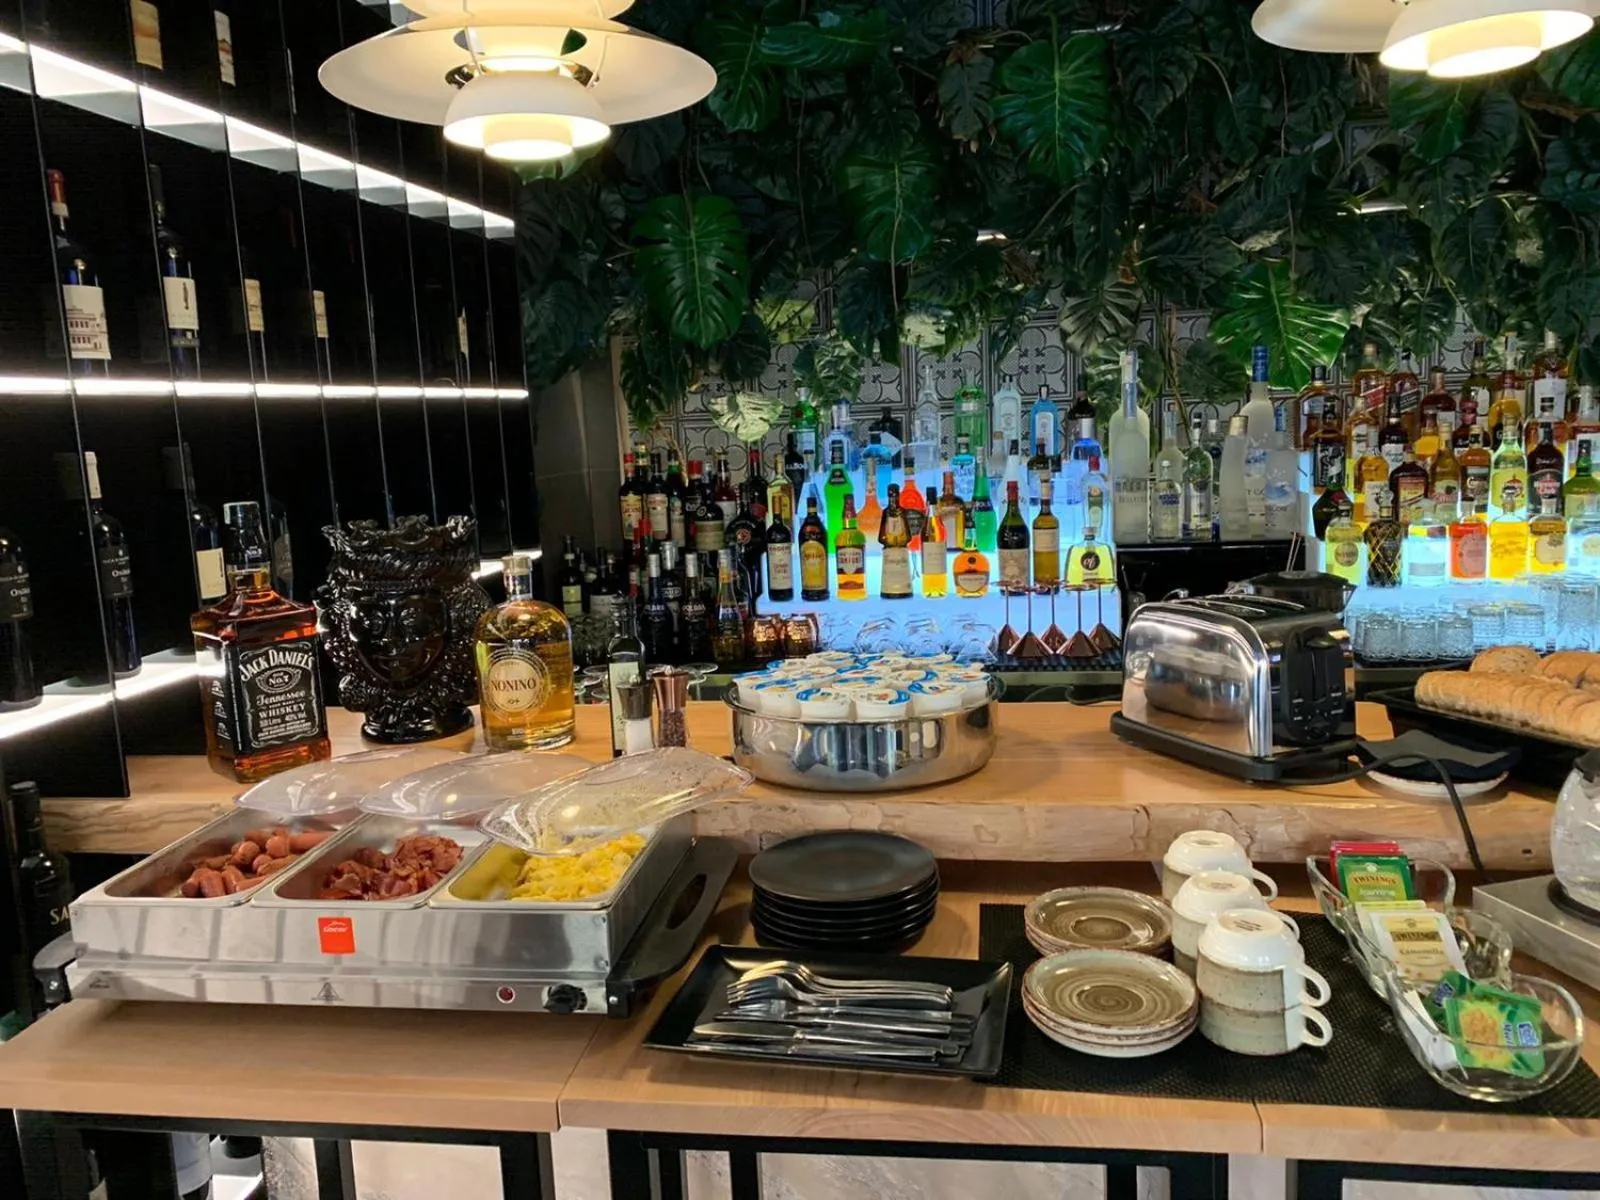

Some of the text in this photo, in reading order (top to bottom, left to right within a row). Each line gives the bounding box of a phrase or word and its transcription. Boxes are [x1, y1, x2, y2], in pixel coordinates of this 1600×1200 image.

[239, 649, 315, 682] JACK DANIEL'S
[491, 678, 537, 692] NONINO
[256, 690, 306, 706] Tennessee
[259, 702, 306, 719] WHISKEY
